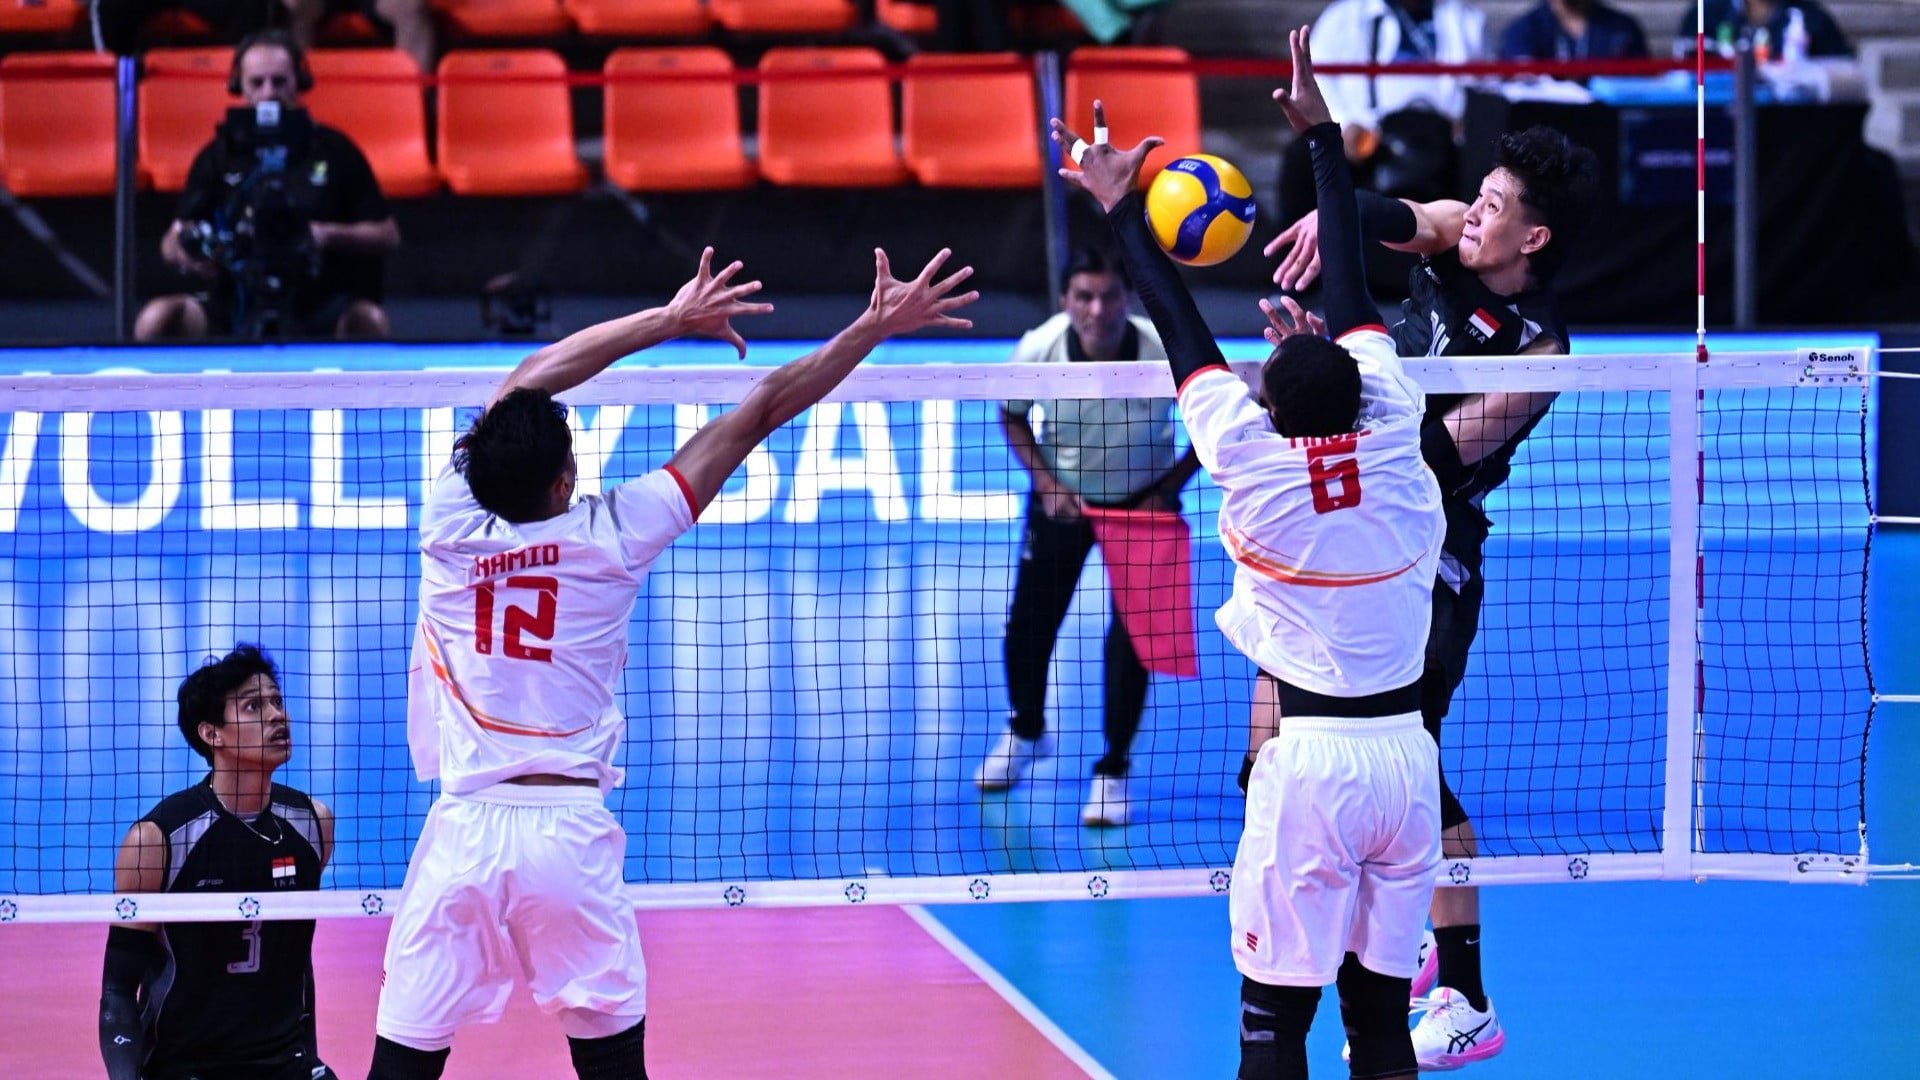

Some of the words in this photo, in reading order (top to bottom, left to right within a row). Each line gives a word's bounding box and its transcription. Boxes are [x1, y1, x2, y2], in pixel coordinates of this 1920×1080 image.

[1819, 353, 1855, 362] Senoh
[1306, 439, 1362, 515] 6
[474, 544, 559, 578] HAMID
[464, 575, 559, 663] 12
[227, 920, 262, 973] 3
